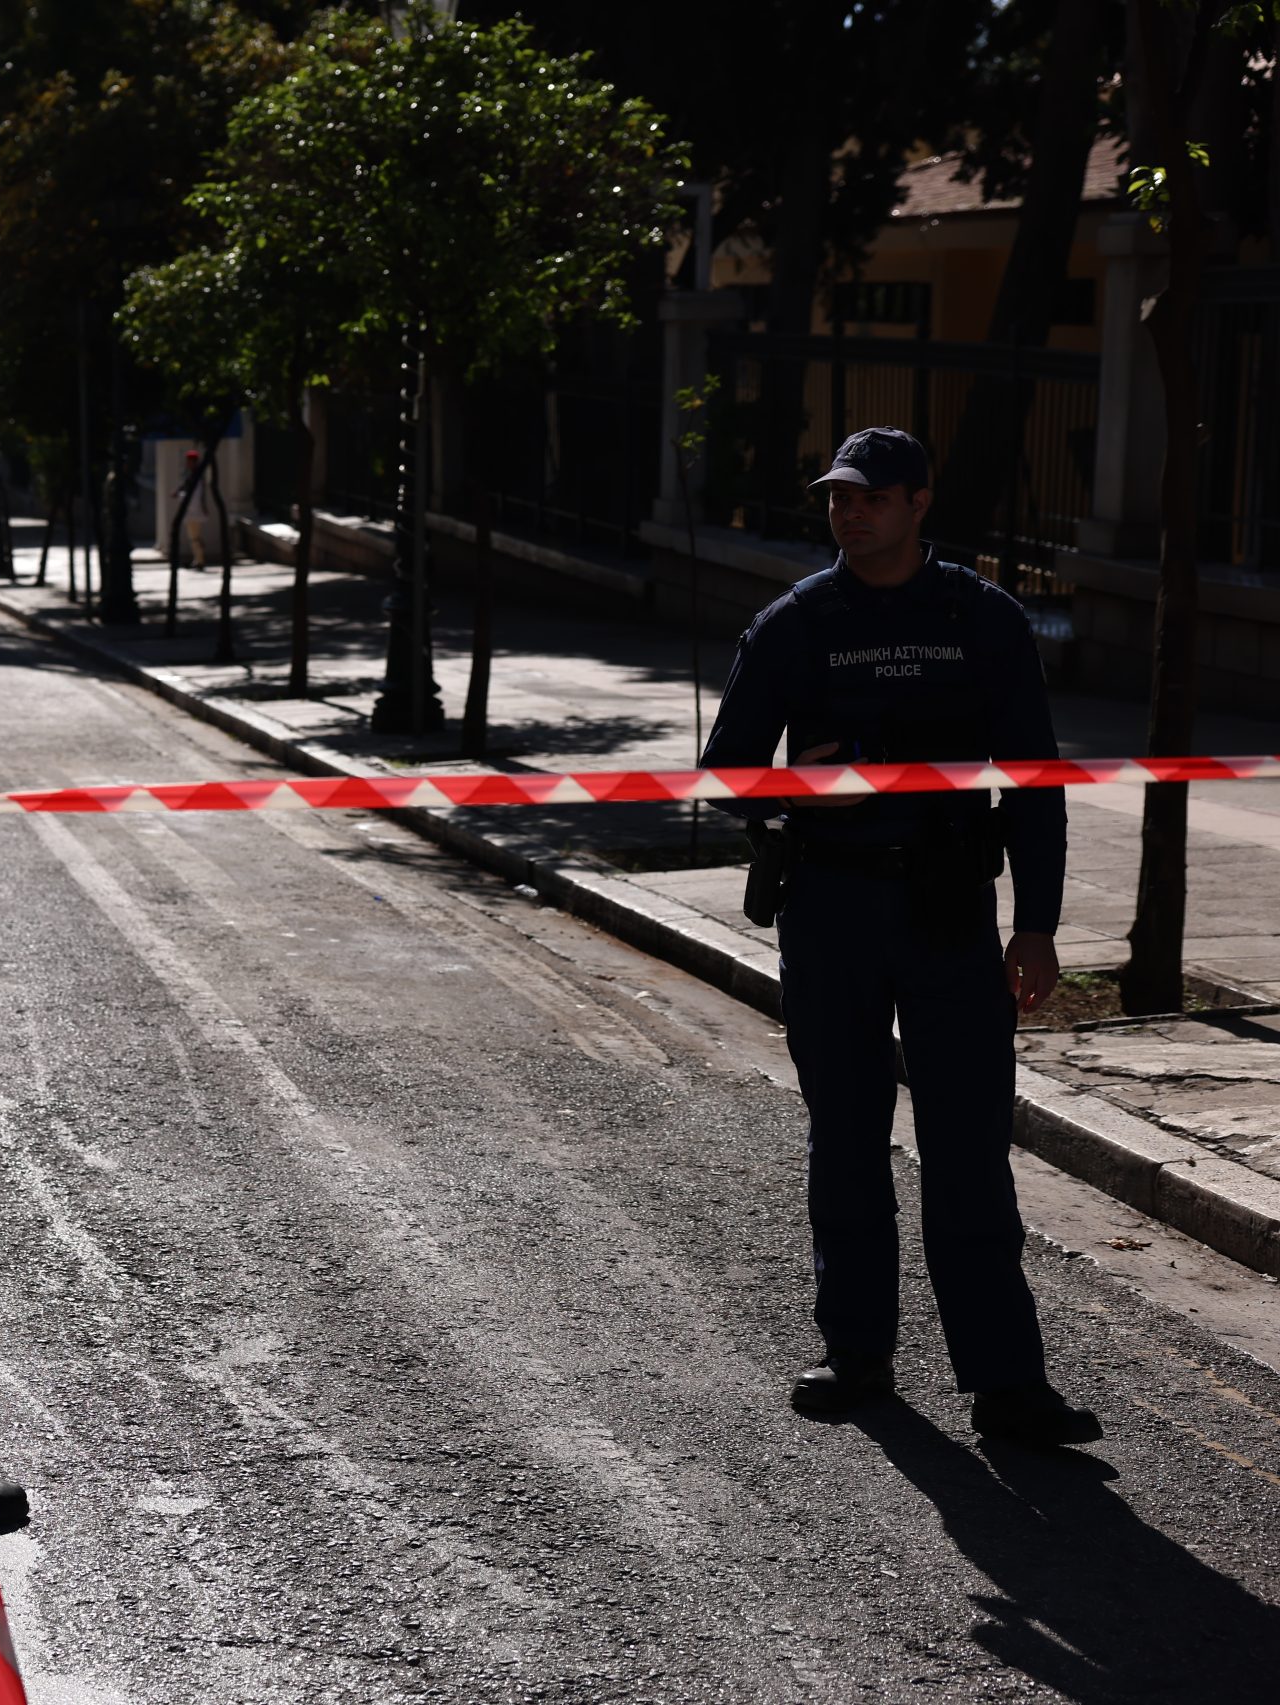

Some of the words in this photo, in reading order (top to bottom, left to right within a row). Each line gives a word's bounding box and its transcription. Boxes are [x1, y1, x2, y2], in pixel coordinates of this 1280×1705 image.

[829, 647, 891, 667] ΕΛΛΗΝΙΚΗ
[894, 646, 964, 660] ΑΣΤΥΝΟΜΙΑ
[875, 664, 922, 678] POLICE
